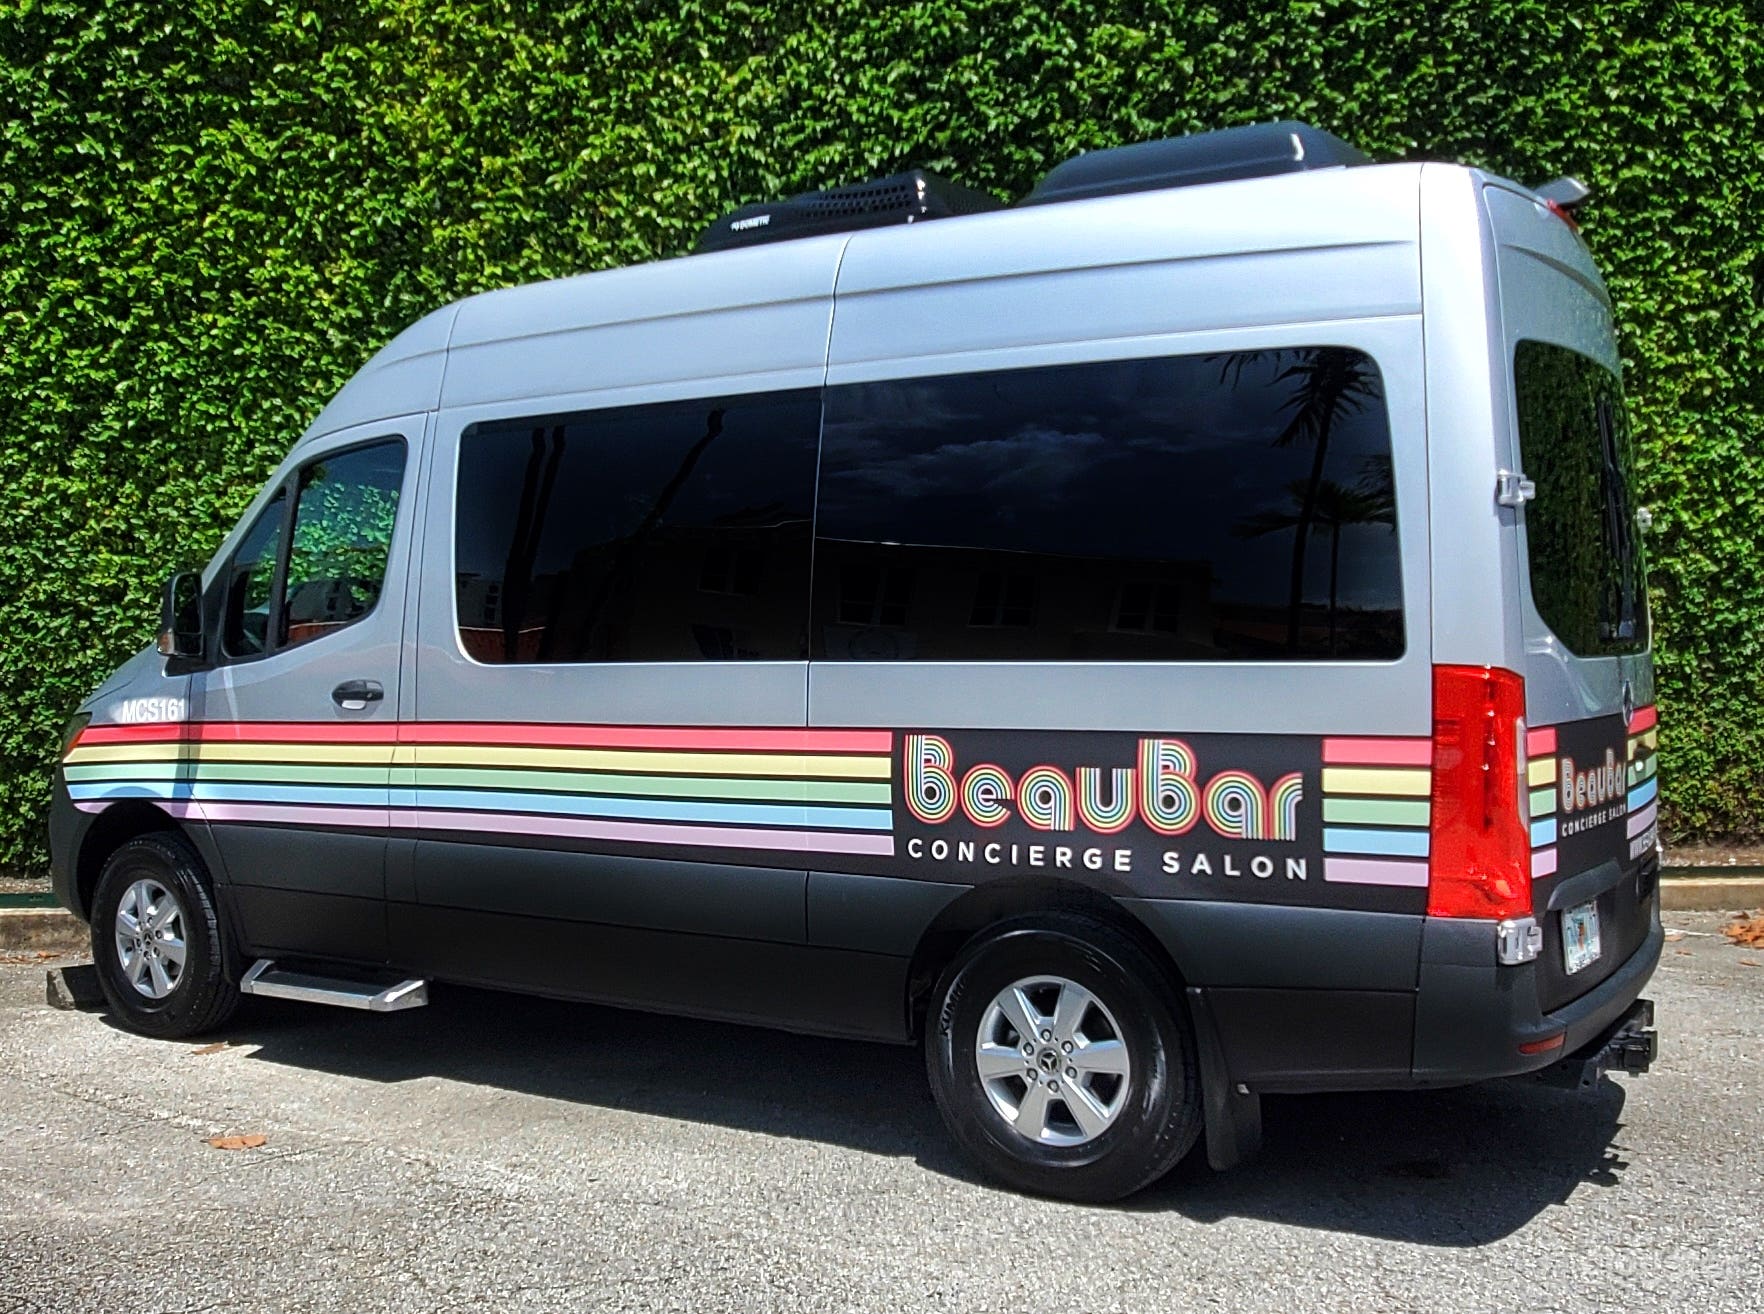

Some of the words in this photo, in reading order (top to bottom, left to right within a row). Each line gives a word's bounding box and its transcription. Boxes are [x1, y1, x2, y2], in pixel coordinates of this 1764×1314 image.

[122, 698, 185, 722] MCS161
[1562, 810, 1607, 837] CONCIERGE
[907, 838, 1132, 872] CONCIERGE
[1162, 851, 1307, 880] SALON
